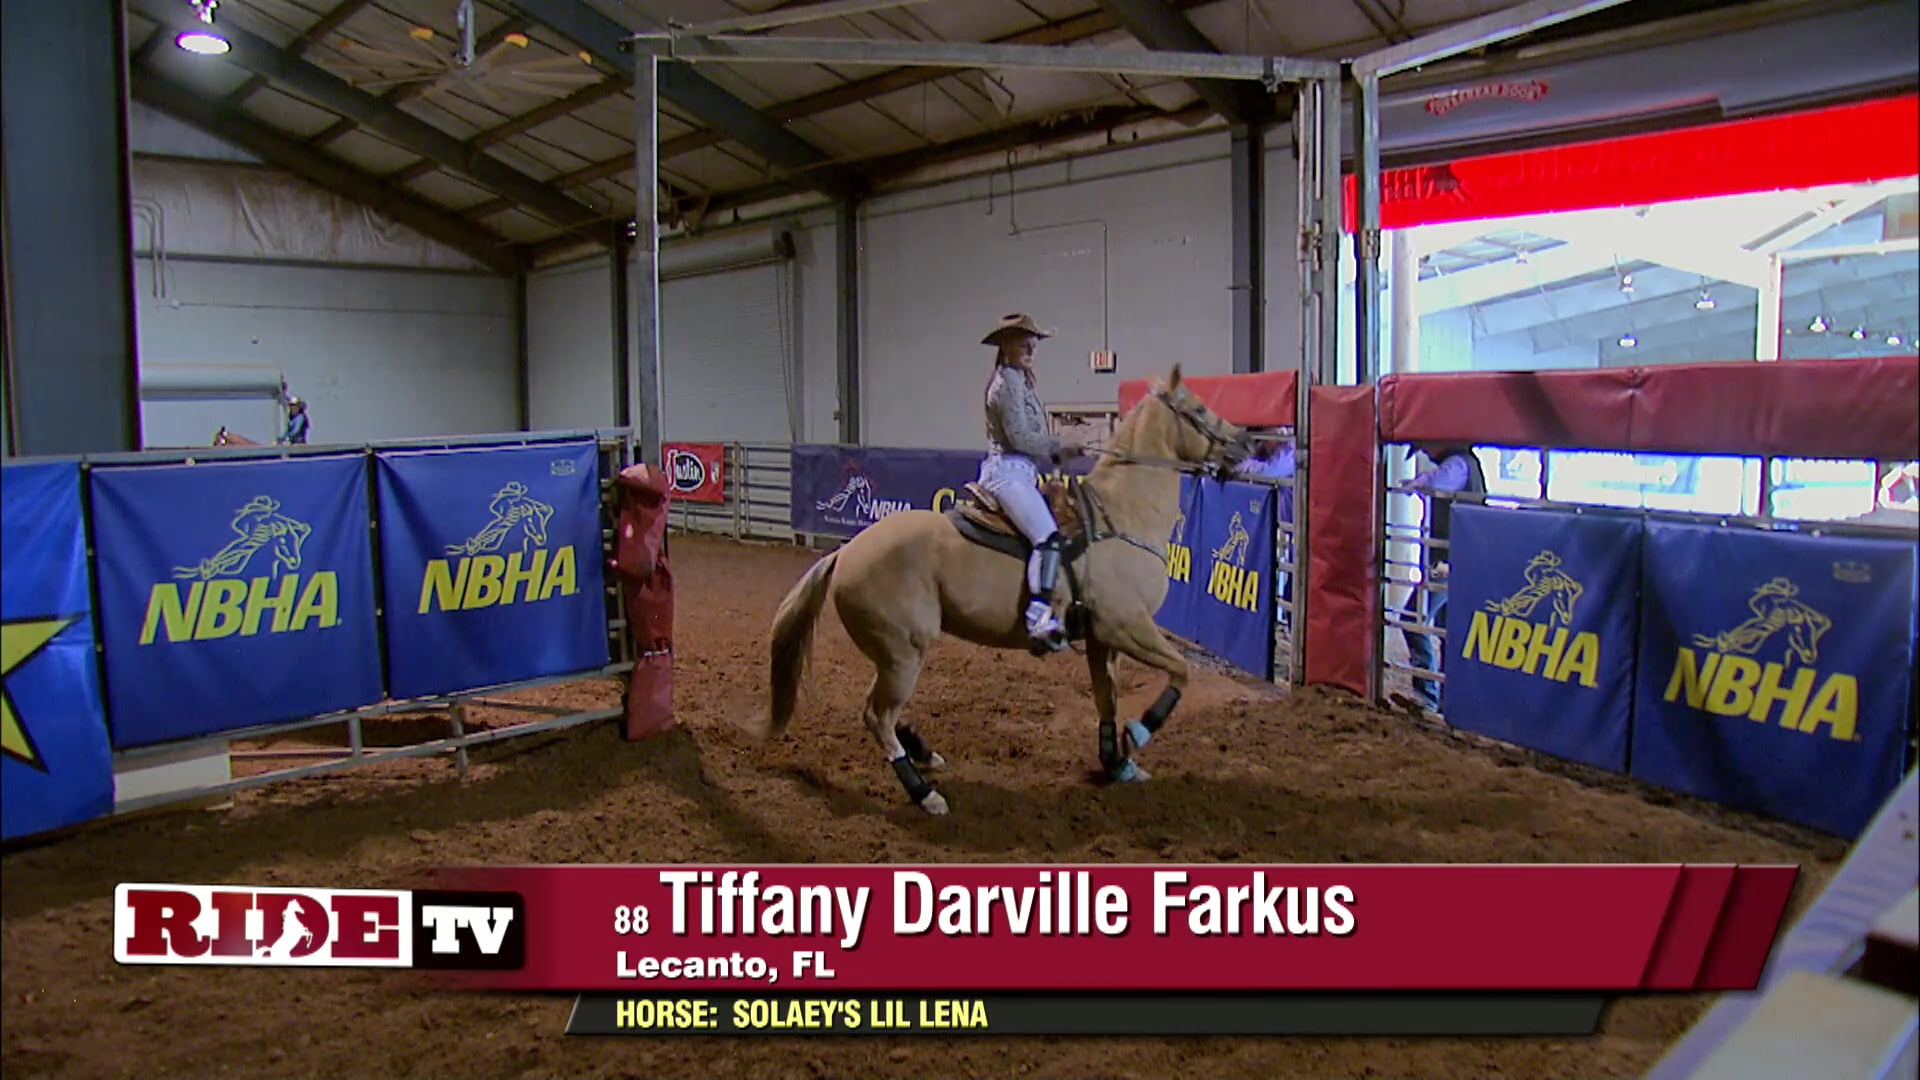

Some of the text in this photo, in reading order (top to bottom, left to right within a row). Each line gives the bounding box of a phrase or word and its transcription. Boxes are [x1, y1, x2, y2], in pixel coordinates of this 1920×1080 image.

[139, 571, 339, 645] NBHA
[418, 545, 577, 615] NBHA
[1462, 611, 1599, 689] NBHA
[1663, 646, 1859, 742] NBHA
